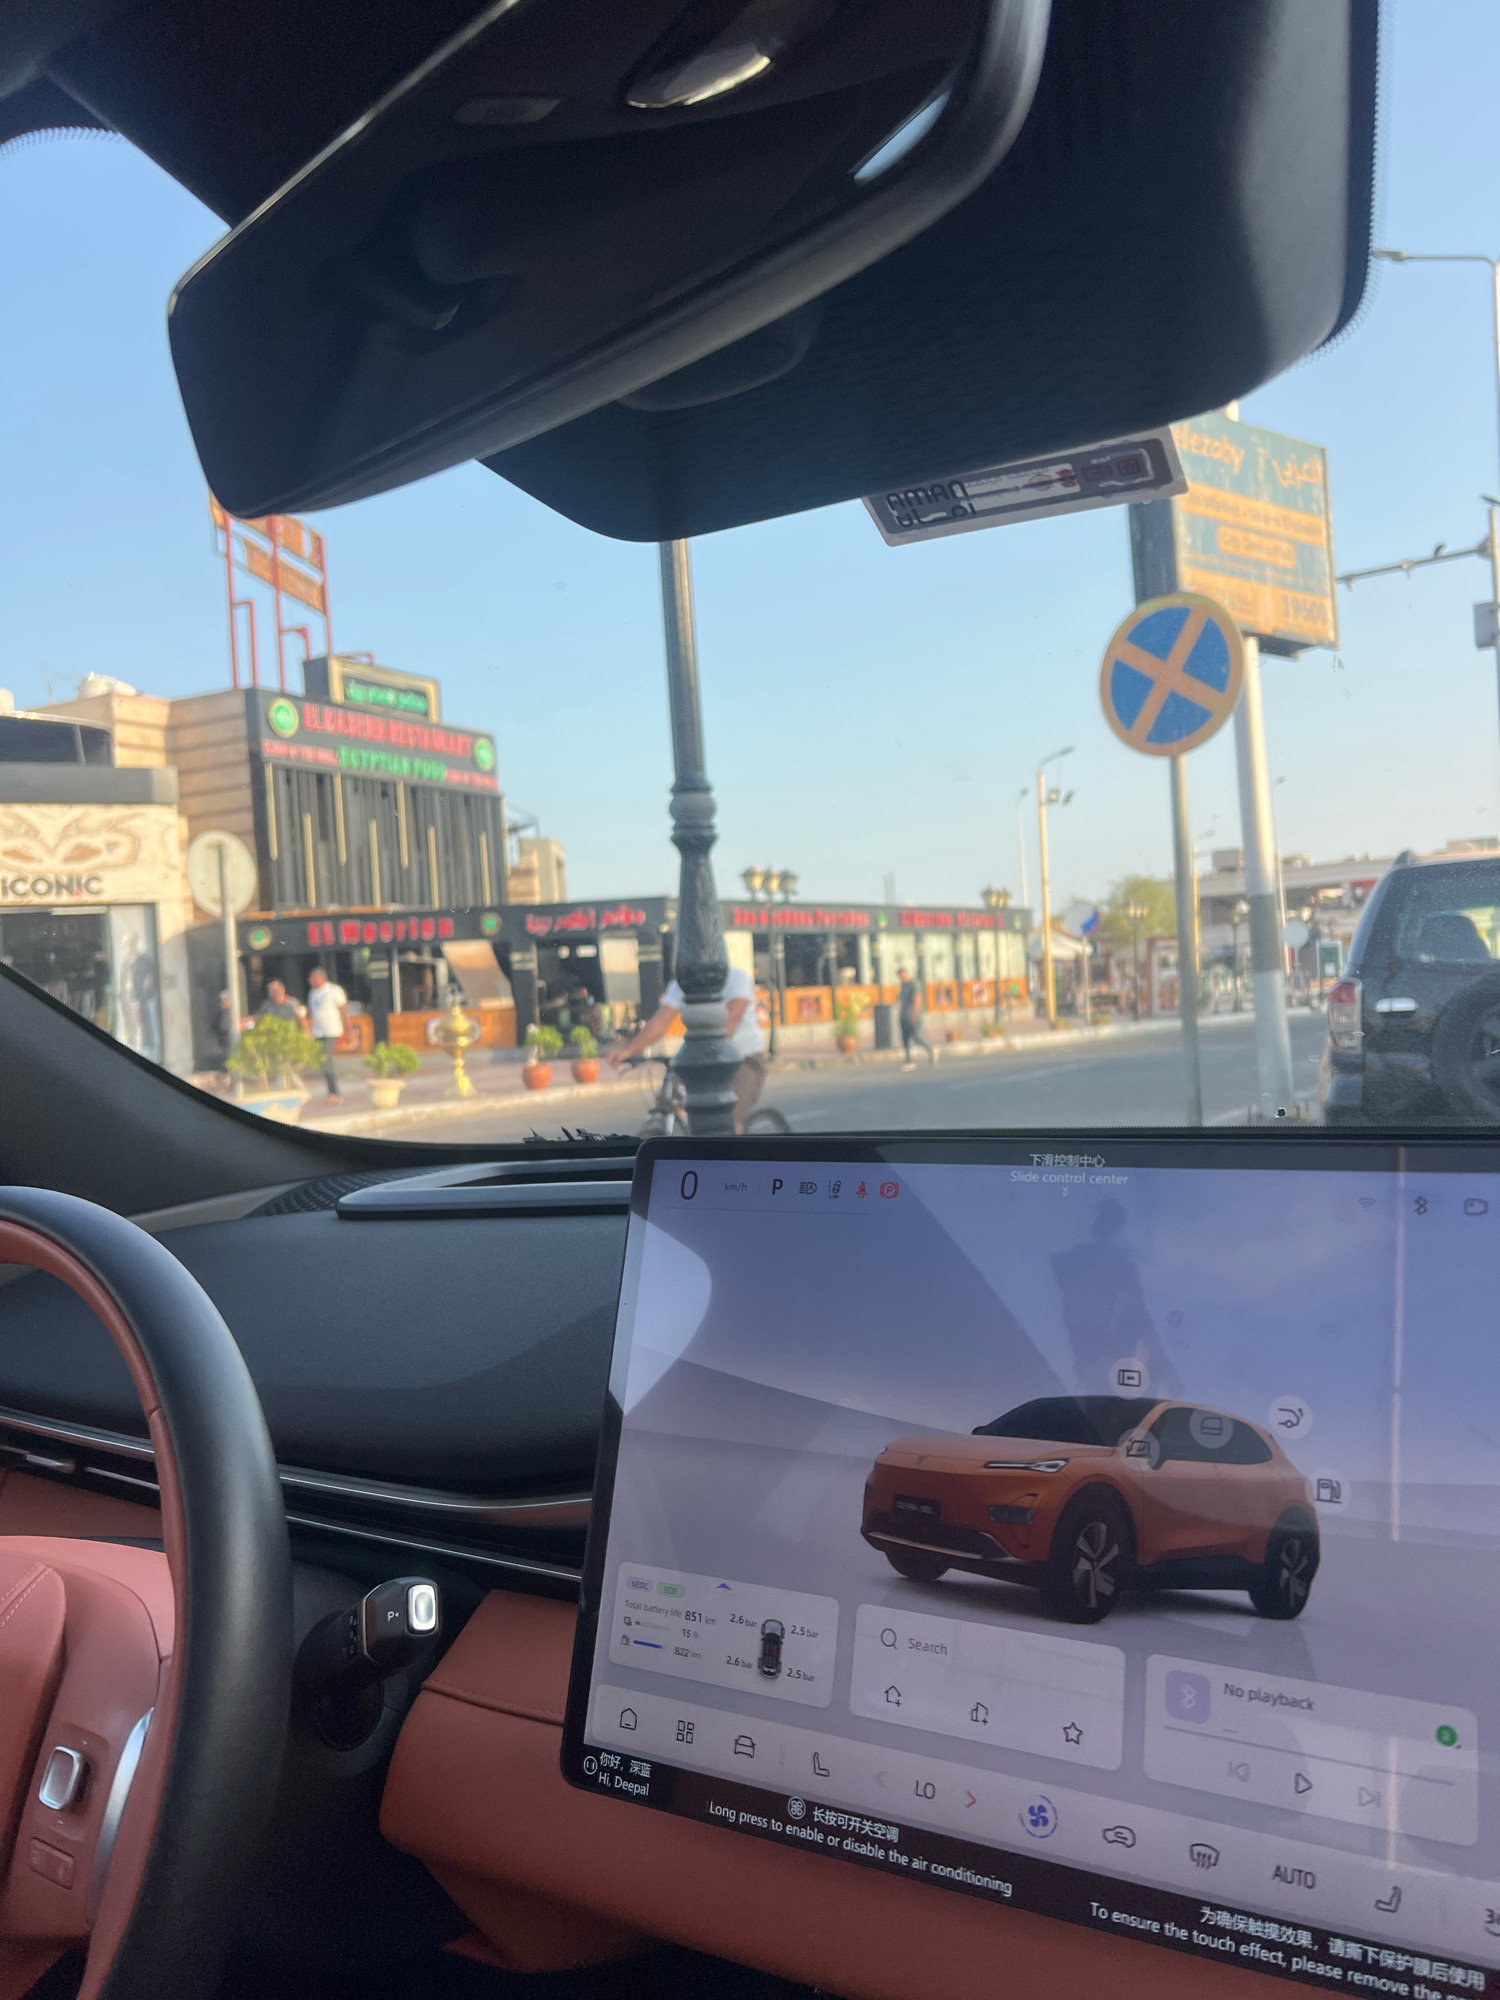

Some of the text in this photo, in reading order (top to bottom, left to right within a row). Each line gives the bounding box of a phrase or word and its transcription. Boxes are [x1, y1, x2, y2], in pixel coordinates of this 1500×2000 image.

[1029, 1153, 1106, 1168] 下滑控制中心
[680, 1170, 748, 1200] 0 km/h
[1010, 1170, 1130, 1185] Slide control center
[771, 1178, 784, 1195] P
[664, 1586, 678, 1595] ECO
[387, 1610, 395, 1622] P
[625, 1600, 642, 1610] Total
[643, 1602, 668, 1617] battery
[670, 1608, 682, 1617] life
[684, 1610, 703, 1623] 851
[730, 1613, 758, 1628] 2.6 bar
[681, 1629, 691, 1638] 15
[790, 1625, 819, 1638] 2.5 bar
[908, 1638, 948, 1655] Search
[726, 1655, 754, 1669] 2.6 bar
[787, 1668, 815, 1682] 2.5 bar
[1223, 1682, 1316, 1712] No playback
[600, 1752, 652, 1778] 你好，深蓝
[598, 1771, 650, 1797] Hi, Deepal
[914, 1780, 936, 1799] LO
[813, 1806, 900, 1844] 长按可开关空调
[709, 1800, 1013, 1898] Long press to enable or disable the air conditioning
[1271, 1864, 1317, 1890] AUTO
[1090, 1901, 1442, 2000] To ensure the touch effect, please remove the
